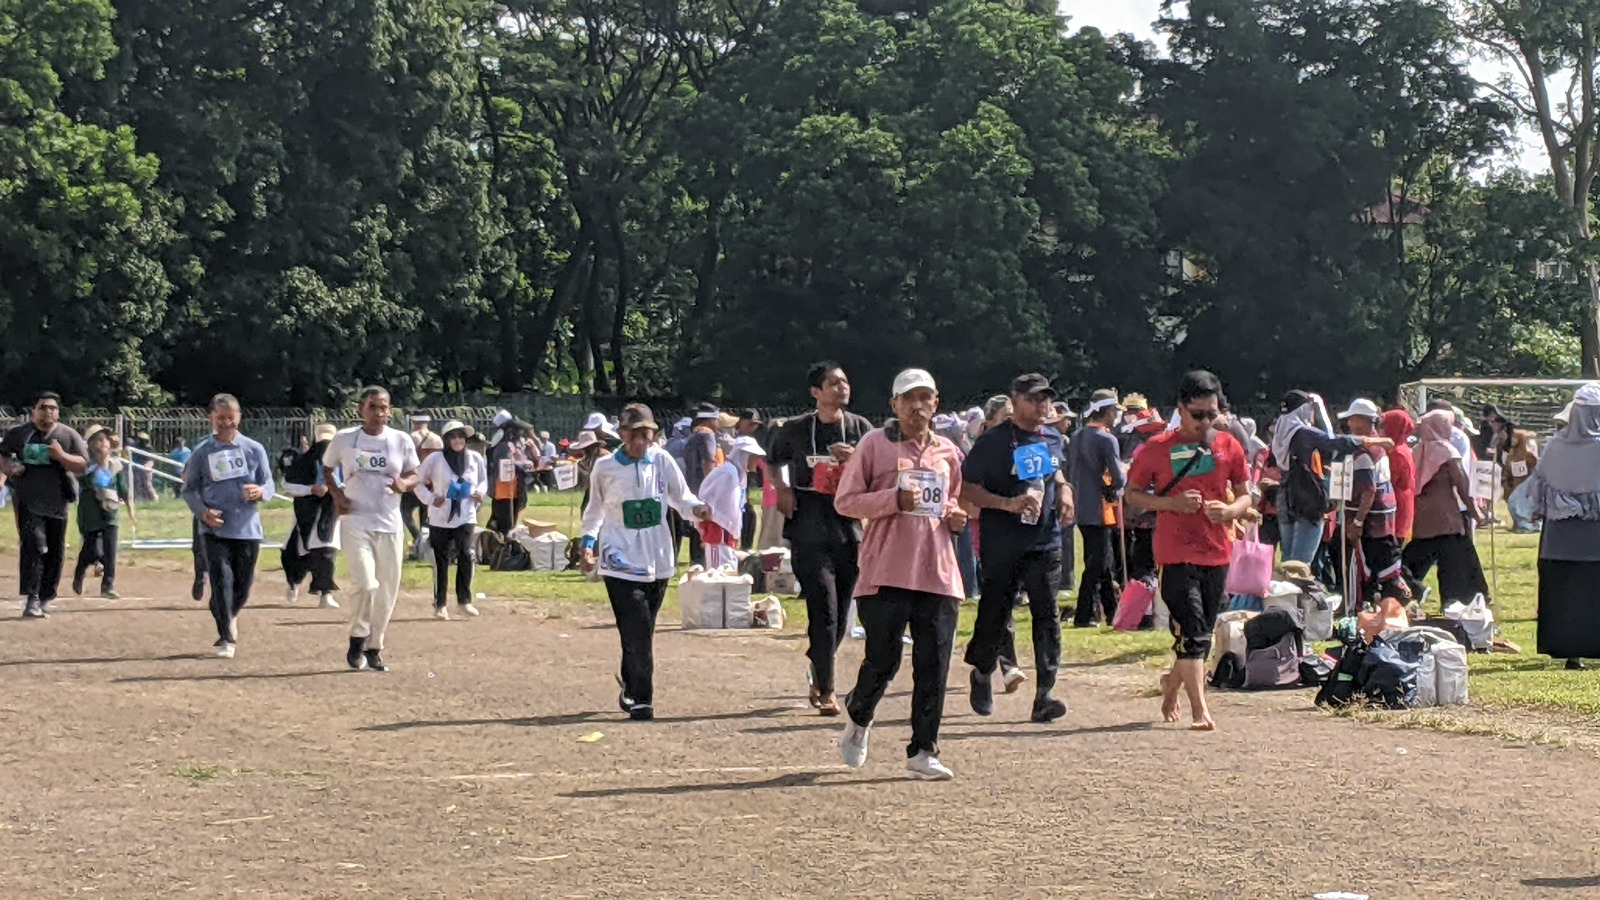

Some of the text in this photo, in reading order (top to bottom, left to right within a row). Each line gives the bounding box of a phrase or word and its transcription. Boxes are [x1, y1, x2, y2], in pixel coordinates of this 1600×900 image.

[229, 457, 244, 470] 10
[370, 456, 387, 468] 08
[1024, 456, 1042, 474] 37
[922, 487, 942, 503] 08
